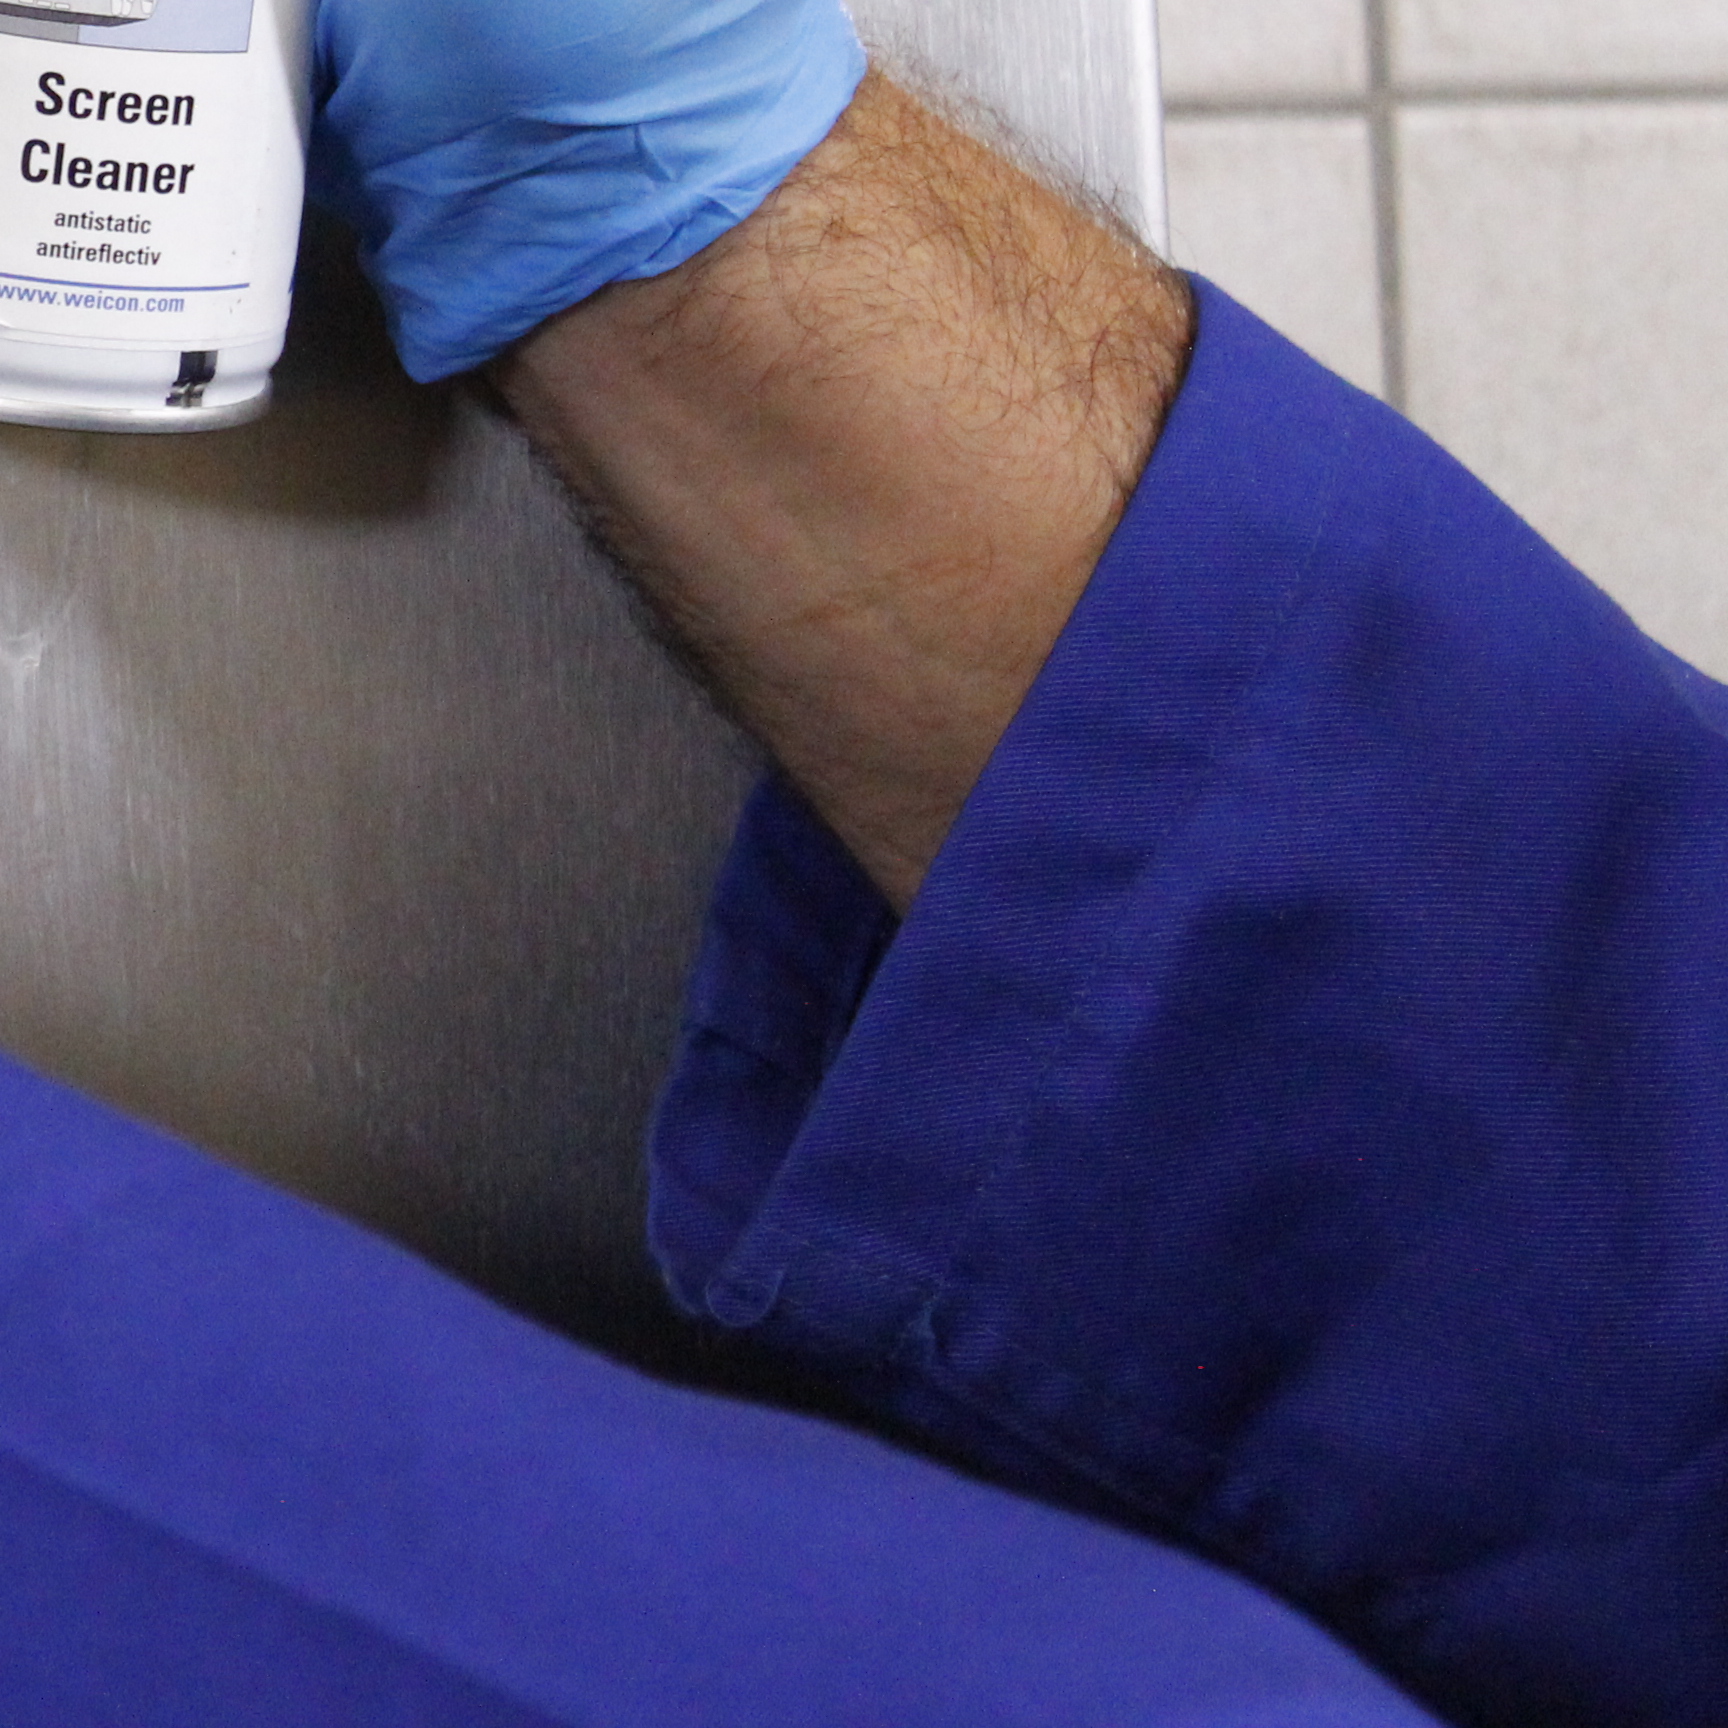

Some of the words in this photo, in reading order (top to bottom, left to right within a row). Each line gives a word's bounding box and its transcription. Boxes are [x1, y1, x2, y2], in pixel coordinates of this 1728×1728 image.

[34, 71, 196, 126] Screen
[19, 138, 196, 195] Cleaner
[53, 210, 153, 235] antistatic
[35, 240, 162, 266] antireflectiv
